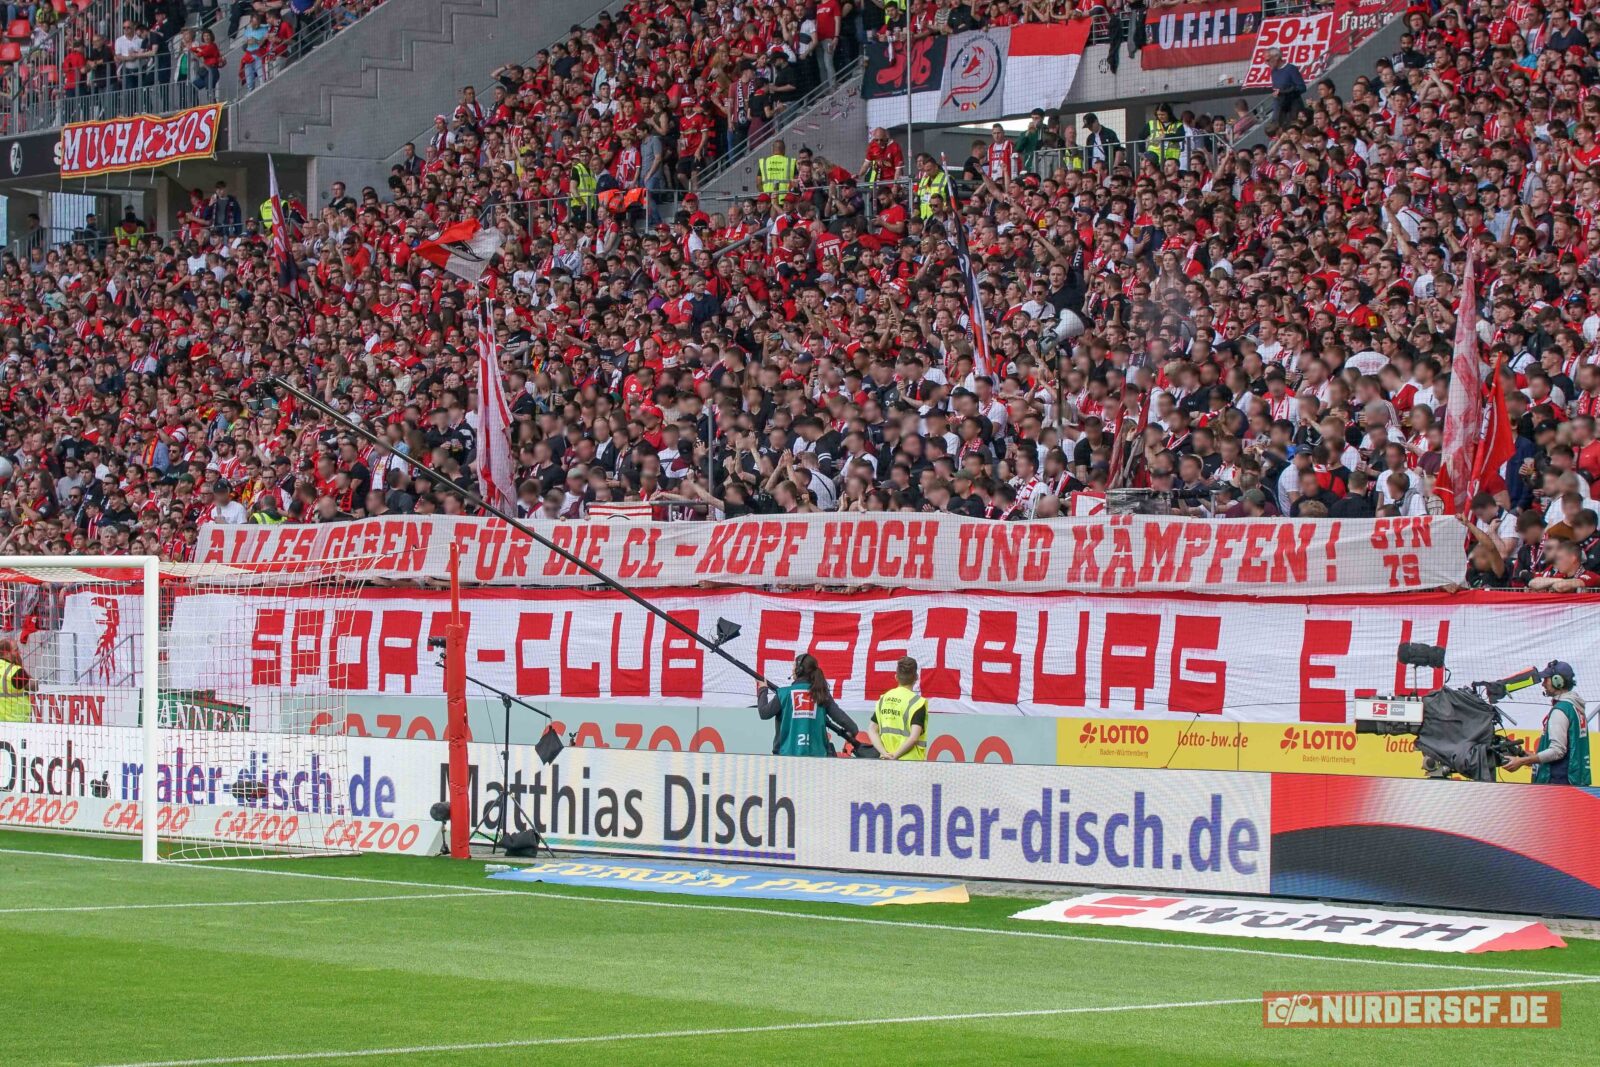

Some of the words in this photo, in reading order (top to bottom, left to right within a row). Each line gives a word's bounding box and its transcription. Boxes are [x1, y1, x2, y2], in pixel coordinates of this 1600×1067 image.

[1158, 7, 1238, 50] U.F.F.F.!
[1257, 16, 1332, 47] 50+1
[1252, 43, 1327, 66] BEIBT
[62, 109, 216, 171] MUCHACHOS
[1371, 515, 1432, 549] SYN
[204, 528, 318, 574] ALLES
[320, 520, 433, 574] GEBEN
[446, 516, 533, 581] FÜR
[543, 524, 610, 577] DIE
[619, 527, 663, 578] CL
[817, 519, 940, 580] HOCH
[959, 523, 1054, 582] UND
[1383, 554, 1422, 588] 79
[756, 606, 1226, 716] FREIBURG
[1099, 725, 1149, 745] LOTTO
[1177, 730, 1249, 748] lotto-bw.de
[1302, 729, 1357, 751] LOTTO
[1302, 754, 1356, 765] Baden-Württemberg
[214, 811, 299, 842] CAZOO
[324, 819, 420, 852] CAZOO
[663, 772, 796, 849] Disch
[849, 783, 1260, 876] maler-disch.de
[1165, 904, 1489, 942] WÜRTH
